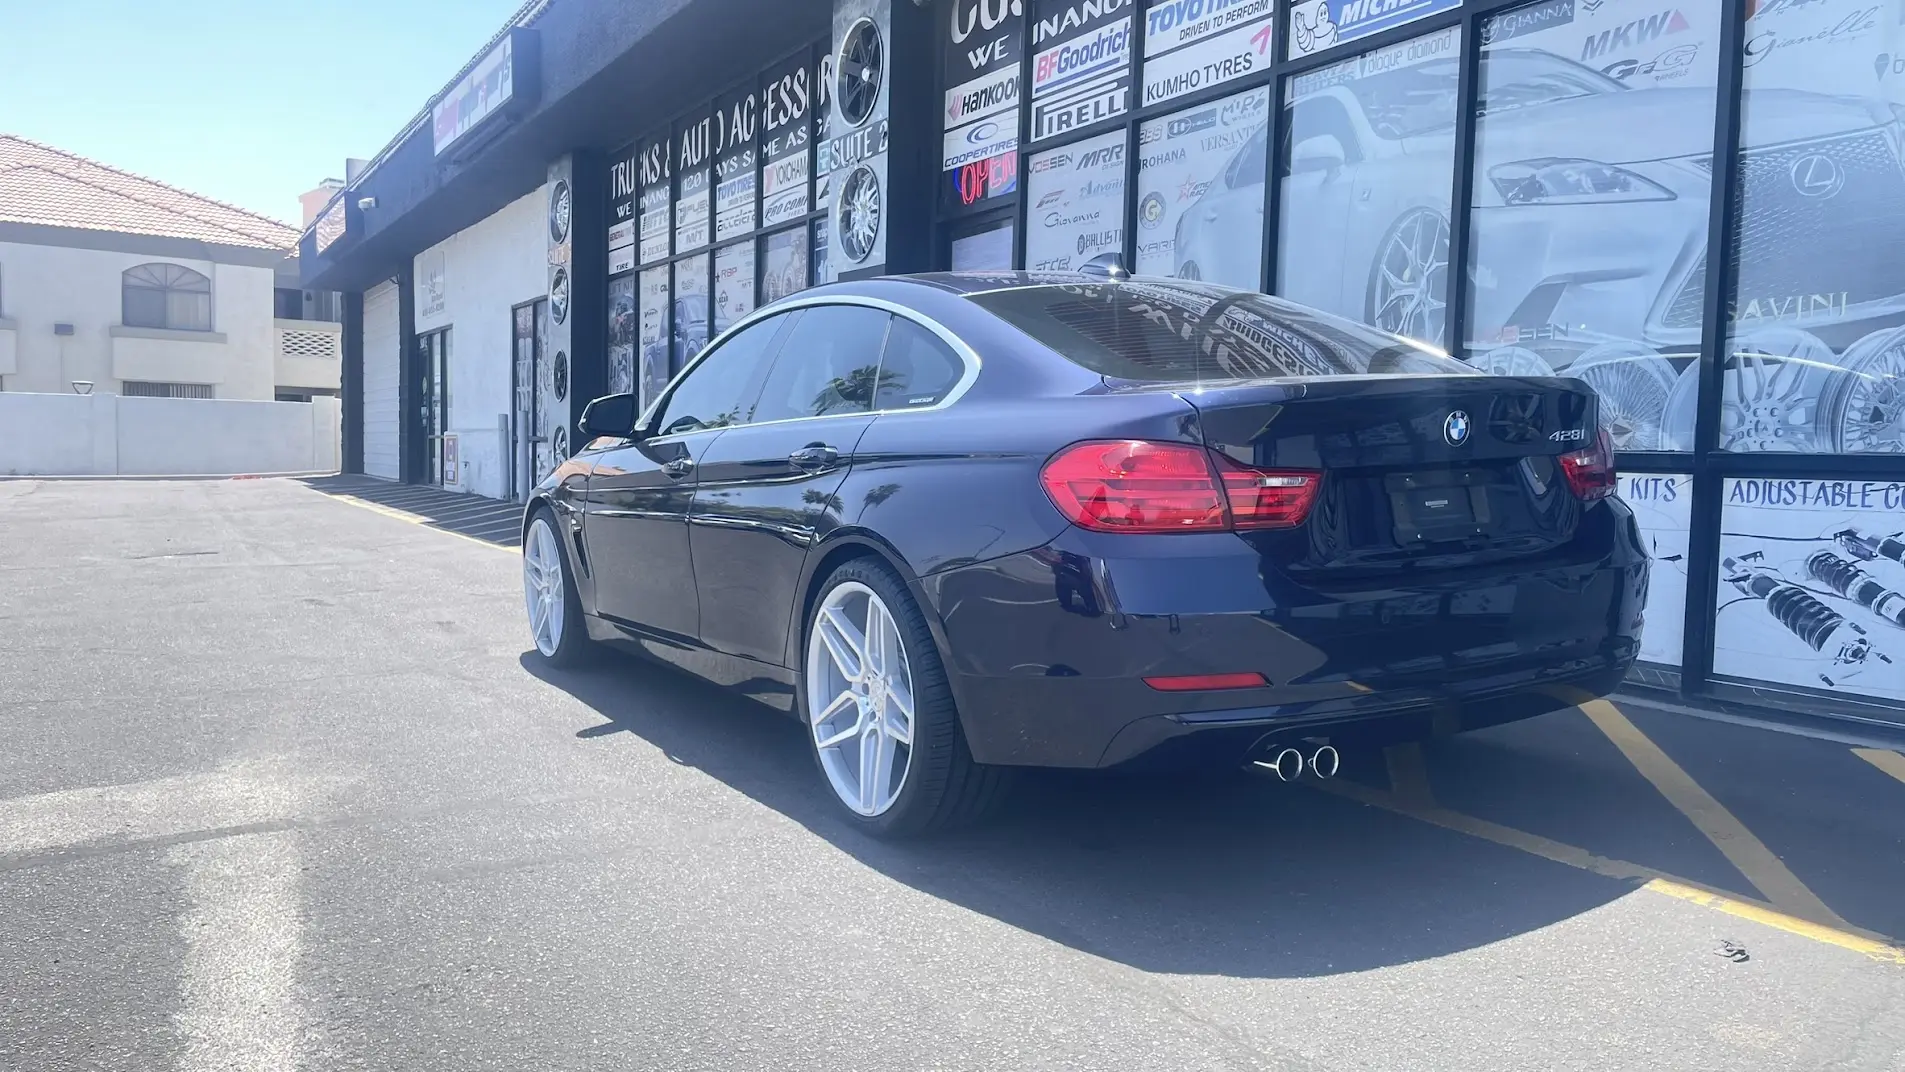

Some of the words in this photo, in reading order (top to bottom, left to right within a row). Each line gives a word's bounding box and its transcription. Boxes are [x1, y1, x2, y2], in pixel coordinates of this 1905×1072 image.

[1180, 20, 1211, 41] DRIVEN
[1213, 15, 1223, 30] TO
[1225, 0, 1269, 24] PERFORM
[1503, 4, 1572, 38] GIANNA
[1581, 11, 1671, 61] MKW
[967, 34, 1010, 70] WE
[1407, 29, 1452, 61] diamond
[1146, 69, 1200, 102] KUMHO
[1203, 52, 1253, 83] TYRES
[830, 127, 873, 170] SUITE
[616, 201, 632, 218] WE
[683, 172, 702, 191] 120
[785, 126, 808, 150] AS
[961, 151, 1016, 205] OPEN
[765, 203, 782, 218] PRO
[616, 262, 629, 271] TIRE
[1630, 477, 1677, 503] KITS
[1730, 479, 1876, 508] ADJUSTABLE
[1884, 482, 1905, 510] C
